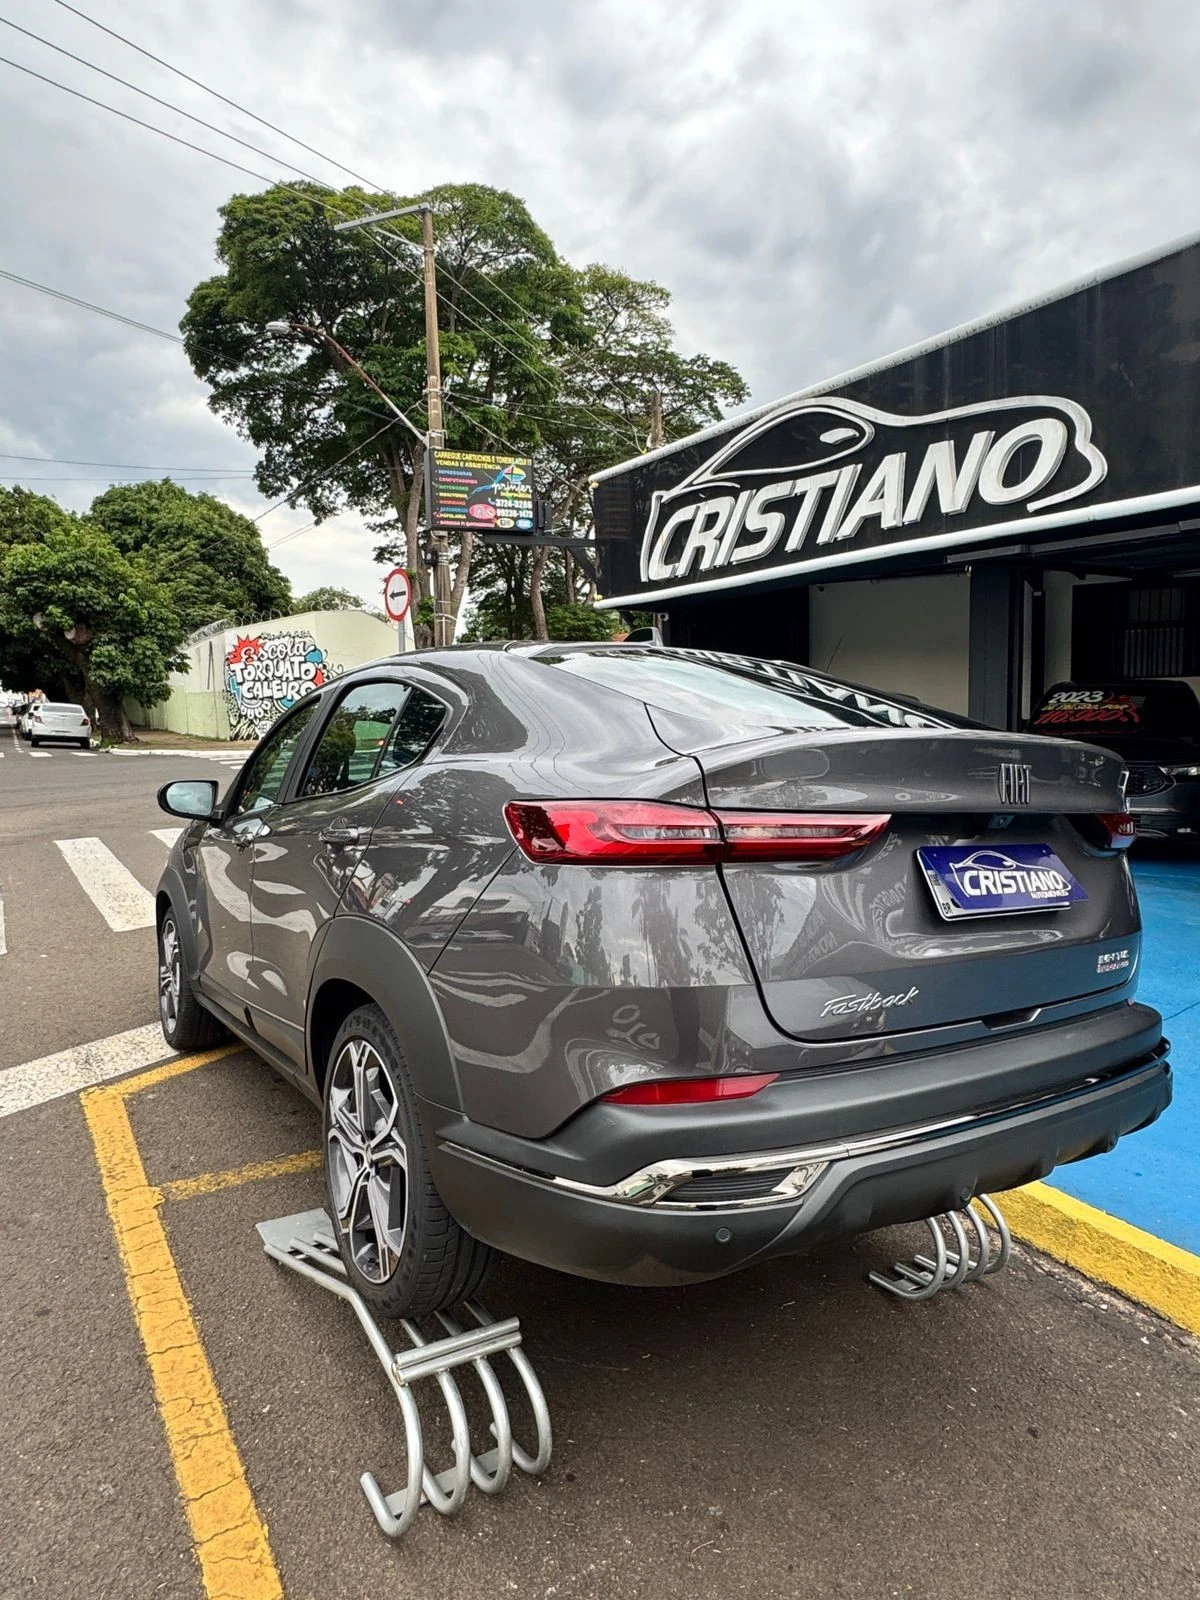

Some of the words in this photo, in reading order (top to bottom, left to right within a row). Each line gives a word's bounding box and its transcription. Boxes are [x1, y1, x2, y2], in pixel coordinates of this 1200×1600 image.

[435, 460, 459, 468] VENDAS
[462, 453, 491, 463] CARTUCHOS
[649, 417, 1069, 581] CRISTIANO
[241, 637, 316, 662] Escola
[230, 657, 317, 683] TORQUATO
[1048, 690, 1104, 703] 2023
[998, 763, 1032, 805] FIAT
[963, 870, 1066, 896] CRISTIANO
[820, 986, 919, 1018] Fastback
